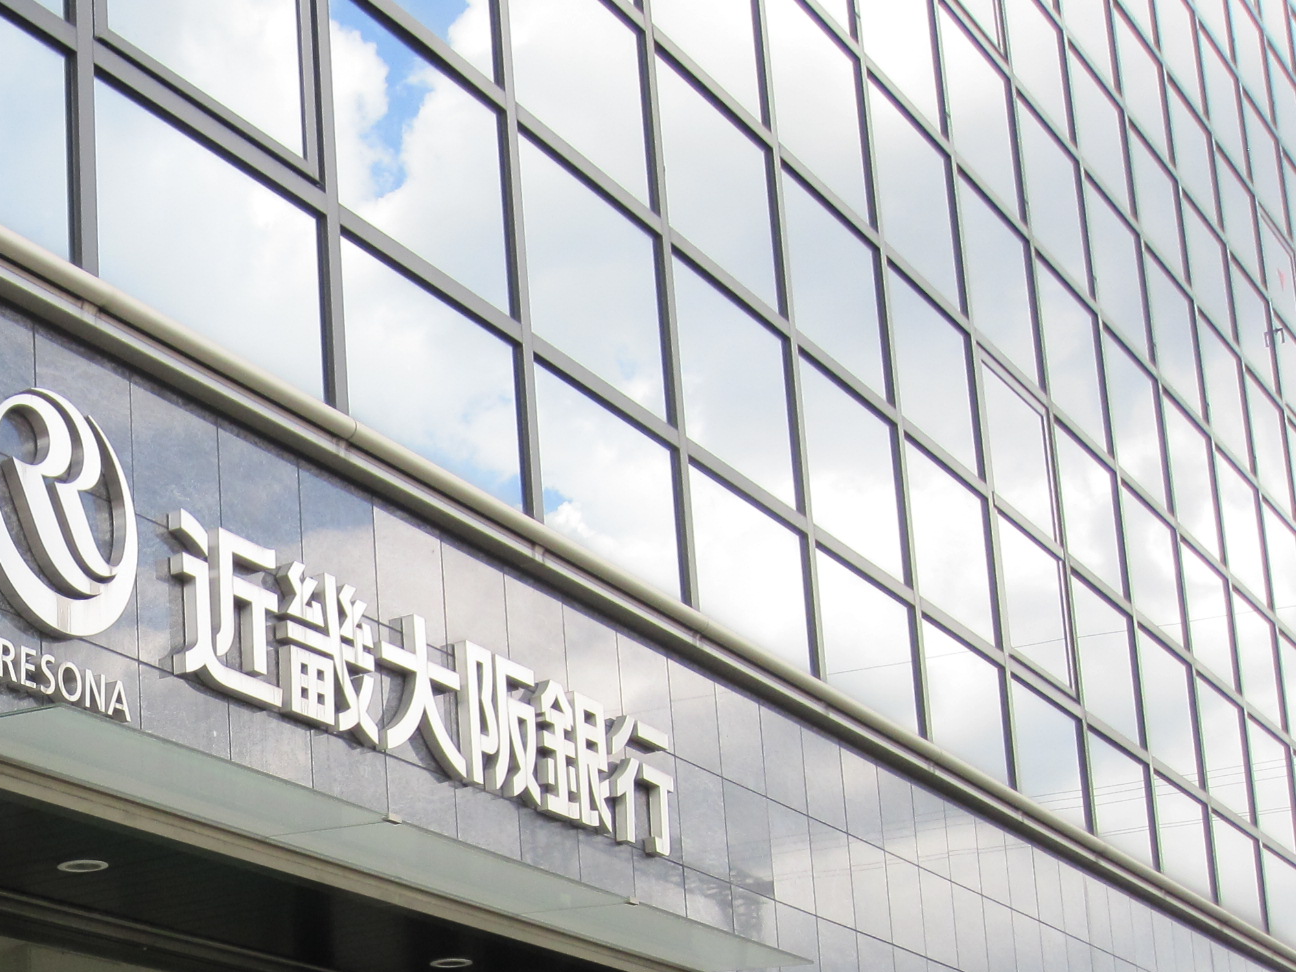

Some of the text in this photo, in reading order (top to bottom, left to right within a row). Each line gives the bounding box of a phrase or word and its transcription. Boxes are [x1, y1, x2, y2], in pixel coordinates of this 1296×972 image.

[168, 508, 674, 857] 近畿大阪銀行
